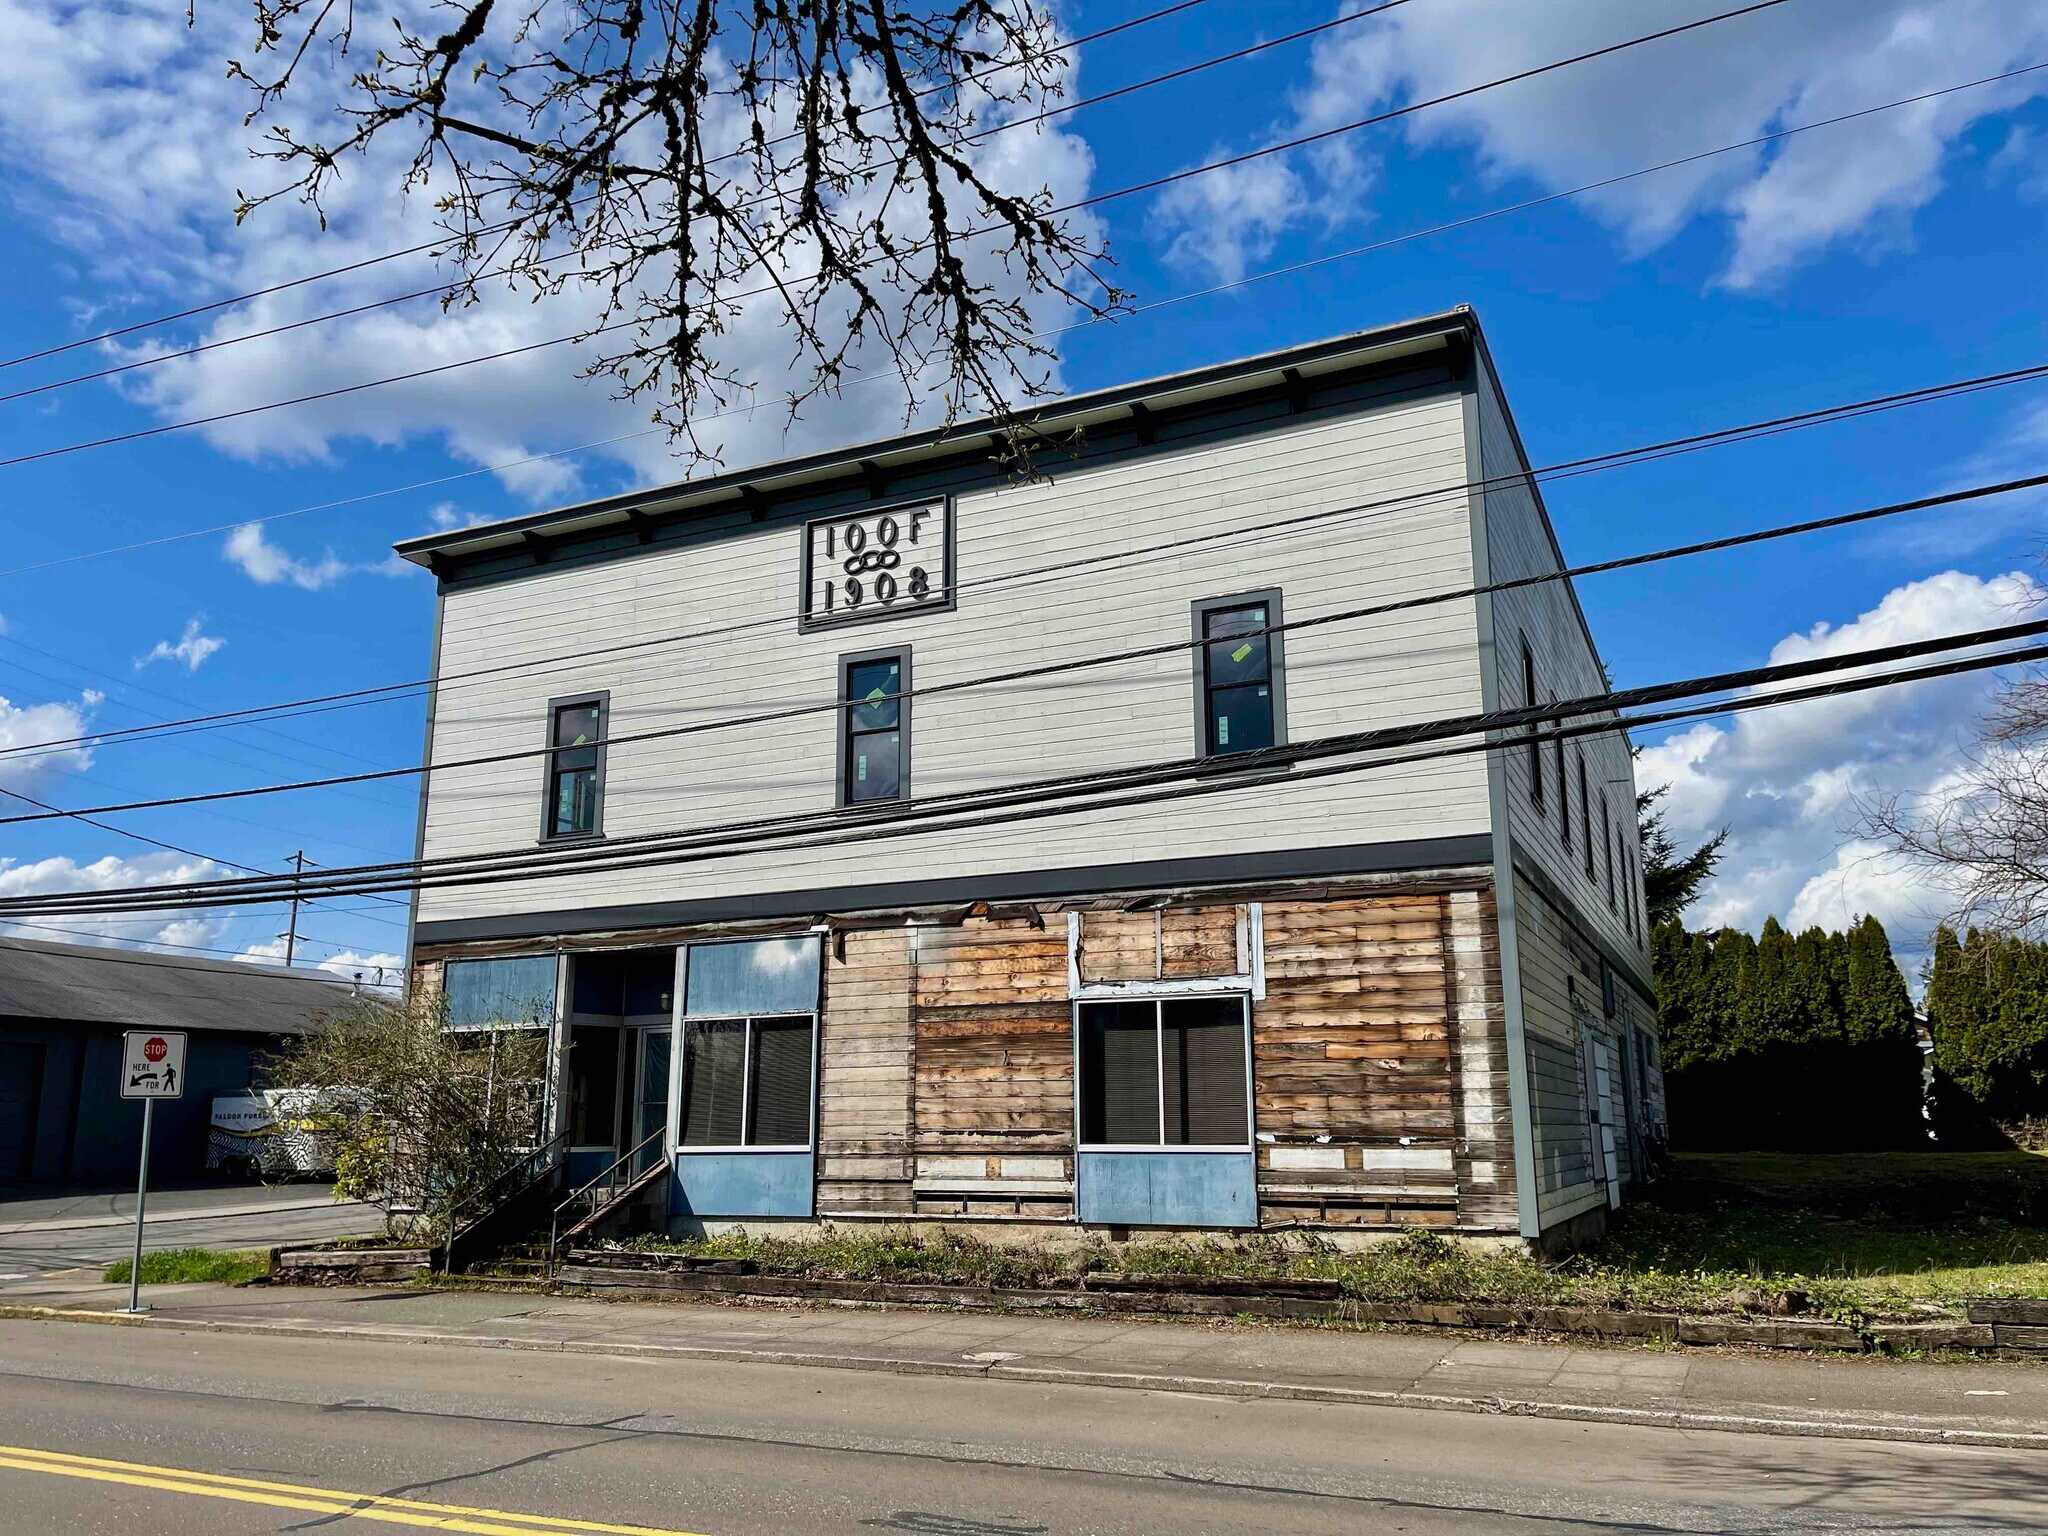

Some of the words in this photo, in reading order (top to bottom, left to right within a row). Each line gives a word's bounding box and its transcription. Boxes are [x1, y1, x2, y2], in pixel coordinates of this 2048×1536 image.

[824, 566, 930, 615] 1908
[144, 1044, 167, 1055] STOP
[132, 1063, 151, 1072] HERE
[145, 1081, 160, 1089] FOR
